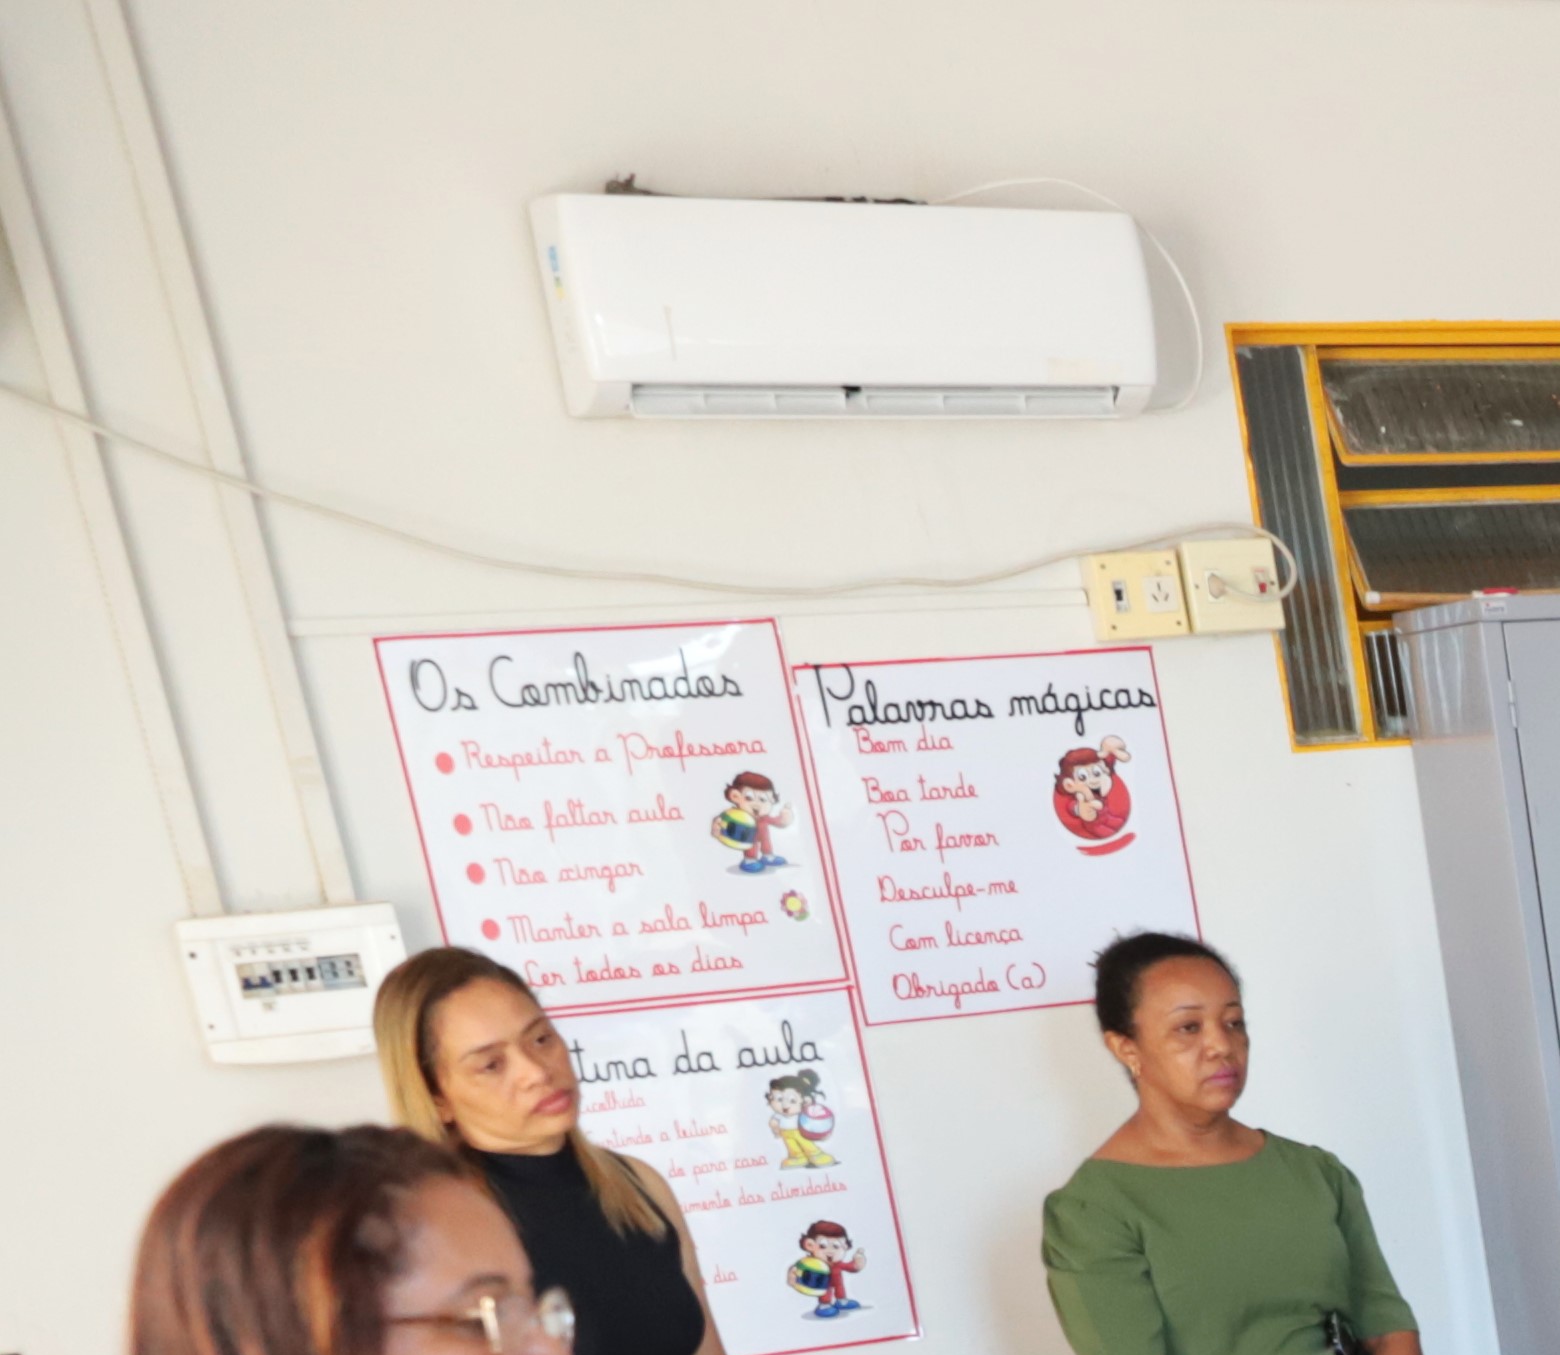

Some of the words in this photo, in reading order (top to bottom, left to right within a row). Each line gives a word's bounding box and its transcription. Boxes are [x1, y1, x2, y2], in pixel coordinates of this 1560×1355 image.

[410, 657, 479, 713] Os
[489, 647, 744, 709] Combinados
[814, 663, 994, 729] Palavras
[1009, 683, 1158, 736] mágicas
[460, 736, 585, 782] Respeitar
[594, 745, 612, 765] a
[617, 729, 768, 775] Professora
[852, 726, 908, 754] Bom
[916, 724, 954, 752] dia
[862, 776, 912, 804] Boa
[917, 772, 979, 802] tarde
[480, 802, 534, 831] Não
[543, 798, 618, 843] faltar
[627, 793, 685, 825] aula
[876, 809, 927, 853] Por
[935, 822, 1000, 864] favor
[493, 857, 549, 888] Não
[557, 859, 645, 893] xingar
[877, 871, 1019, 913] Desculpe-me
[510, 912, 602, 945] Manter
[611, 918, 630, 938] a
[638, 904, 693, 935] sala
[698, 900, 769, 937] limpa
[889, 924, 939, 951] Com
[945, 920, 1023, 948] licença
[575, 953, 643, 984] todos
[651, 961, 682, 977] os
[690, 943, 744, 974] dias
[892, 967, 1000, 1010] Obrigado
[1005, 962, 1047, 992] (a)
[672, 1029, 719, 1076] da
[736, 1019, 823, 1070] aula
[675, 1121, 729, 1139] leitura
[693, 1160, 727, 1185] para
[734, 1155, 768, 1169] casa
[738, 1187, 765, 1207] das
[770, 1178, 848, 1203] atividades
